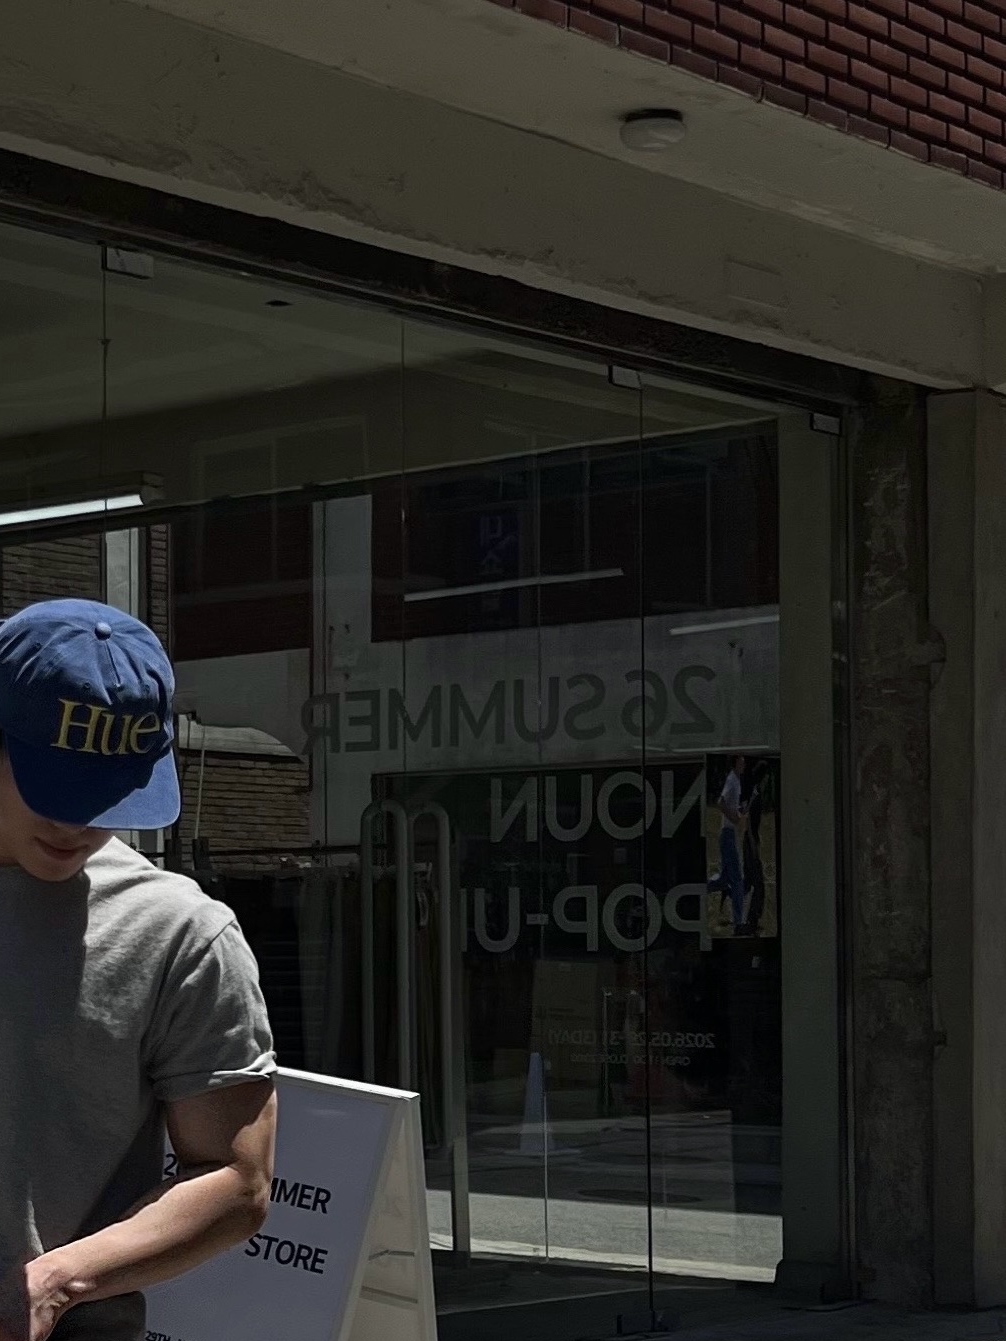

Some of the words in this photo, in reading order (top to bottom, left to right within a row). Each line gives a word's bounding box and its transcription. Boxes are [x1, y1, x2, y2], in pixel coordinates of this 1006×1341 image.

[50, 698, 161, 756] Hue
[164, 1153, 180, 1177] 2
[244, 1232, 329, 1275] STORE
